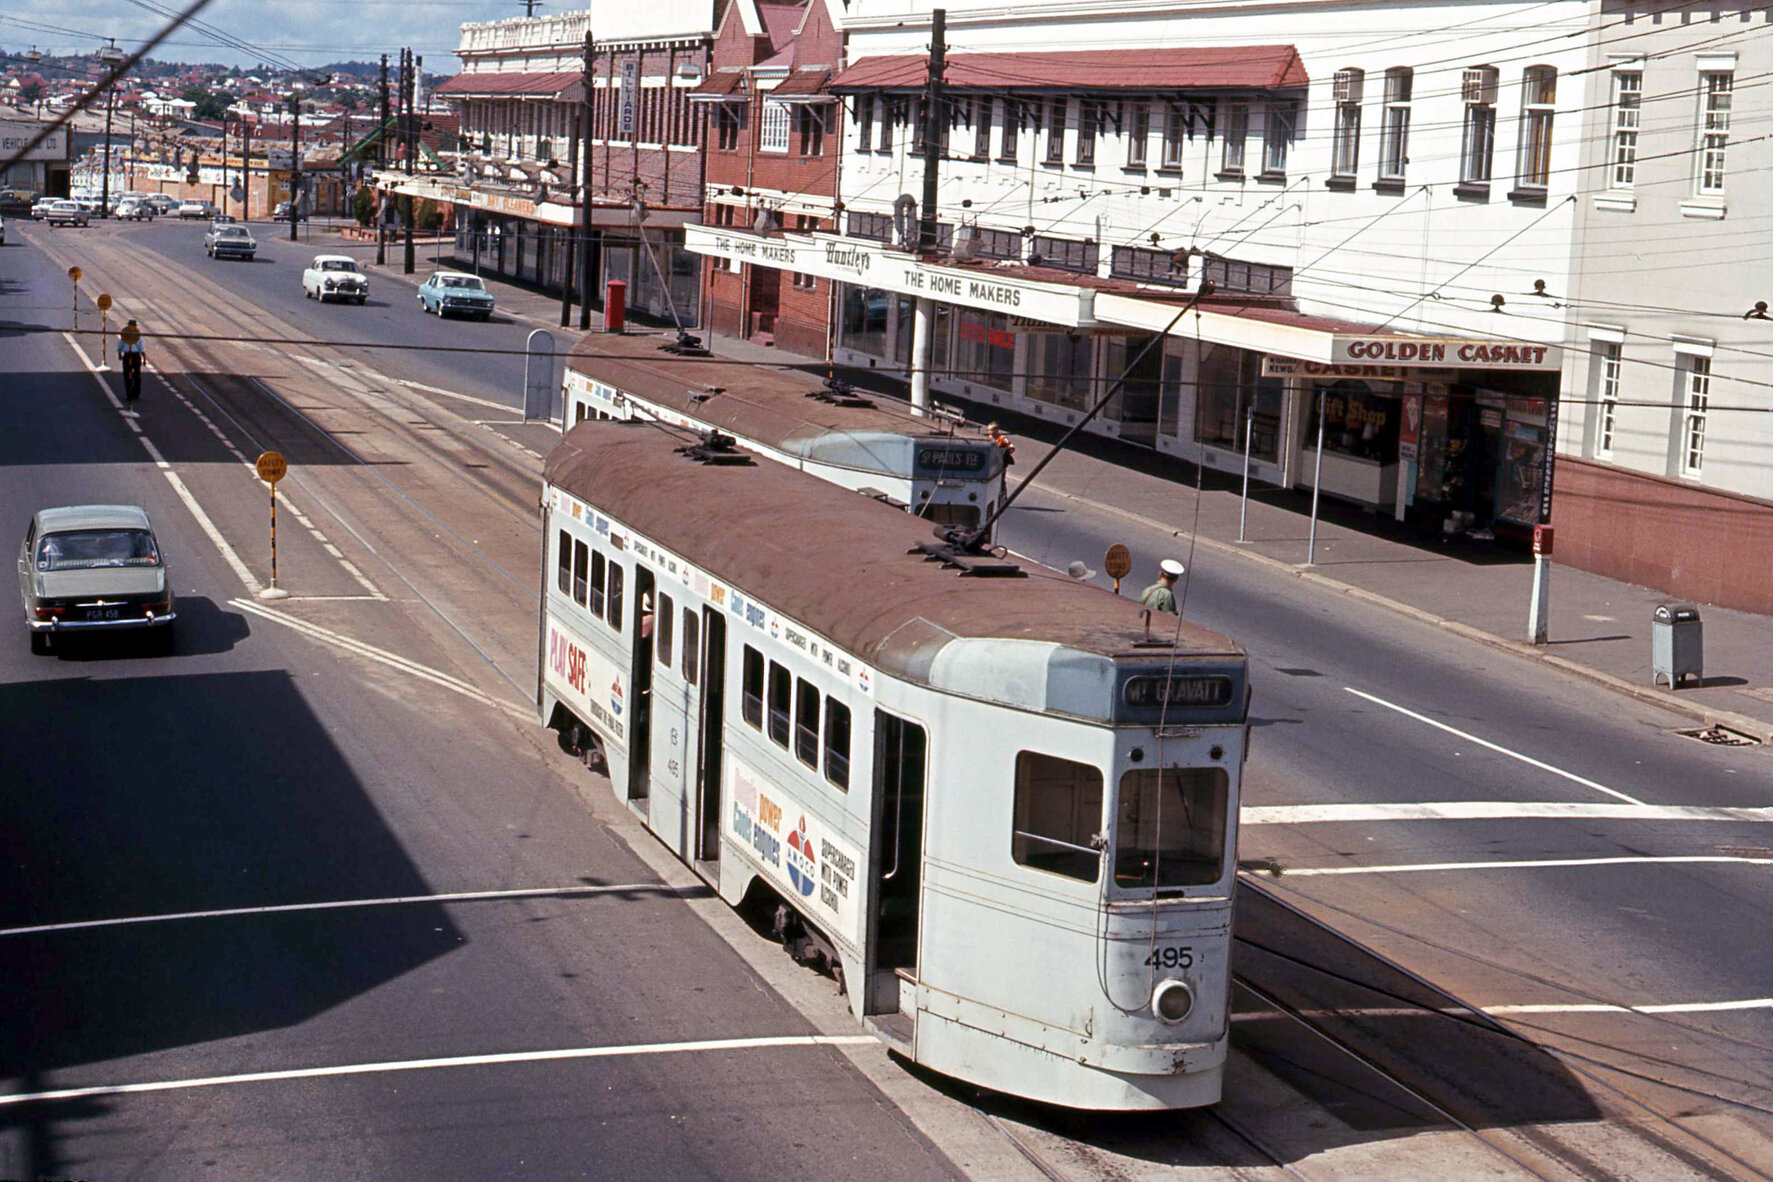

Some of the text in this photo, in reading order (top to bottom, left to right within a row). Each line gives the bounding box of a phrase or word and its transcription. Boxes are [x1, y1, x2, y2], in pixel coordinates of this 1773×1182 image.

[623, 63, 634, 131] BILLIARDS
[503, 196, 537, 215] CLEANERS
[715, 236, 796, 264] THE HOME MAKERS
[904, 270, 1021, 307] THE HOME MAKERS
[1347, 340, 1548, 364] GOLDEN CASKET
[1349, 401, 1387, 430] Shop
[550, 627, 569, 678] PLAY
[1156, 680, 1220, 701] GRAVATT
[759, 793, 783, 833] power
[753, 822, 781, 869] engines
[821, 837, 856, 881] SUPERCHARGED
[786, 847, 816, 878] AMOCO
[832, 869, 849, 899] POWER
[1144, 946, 1194, 971] 495
